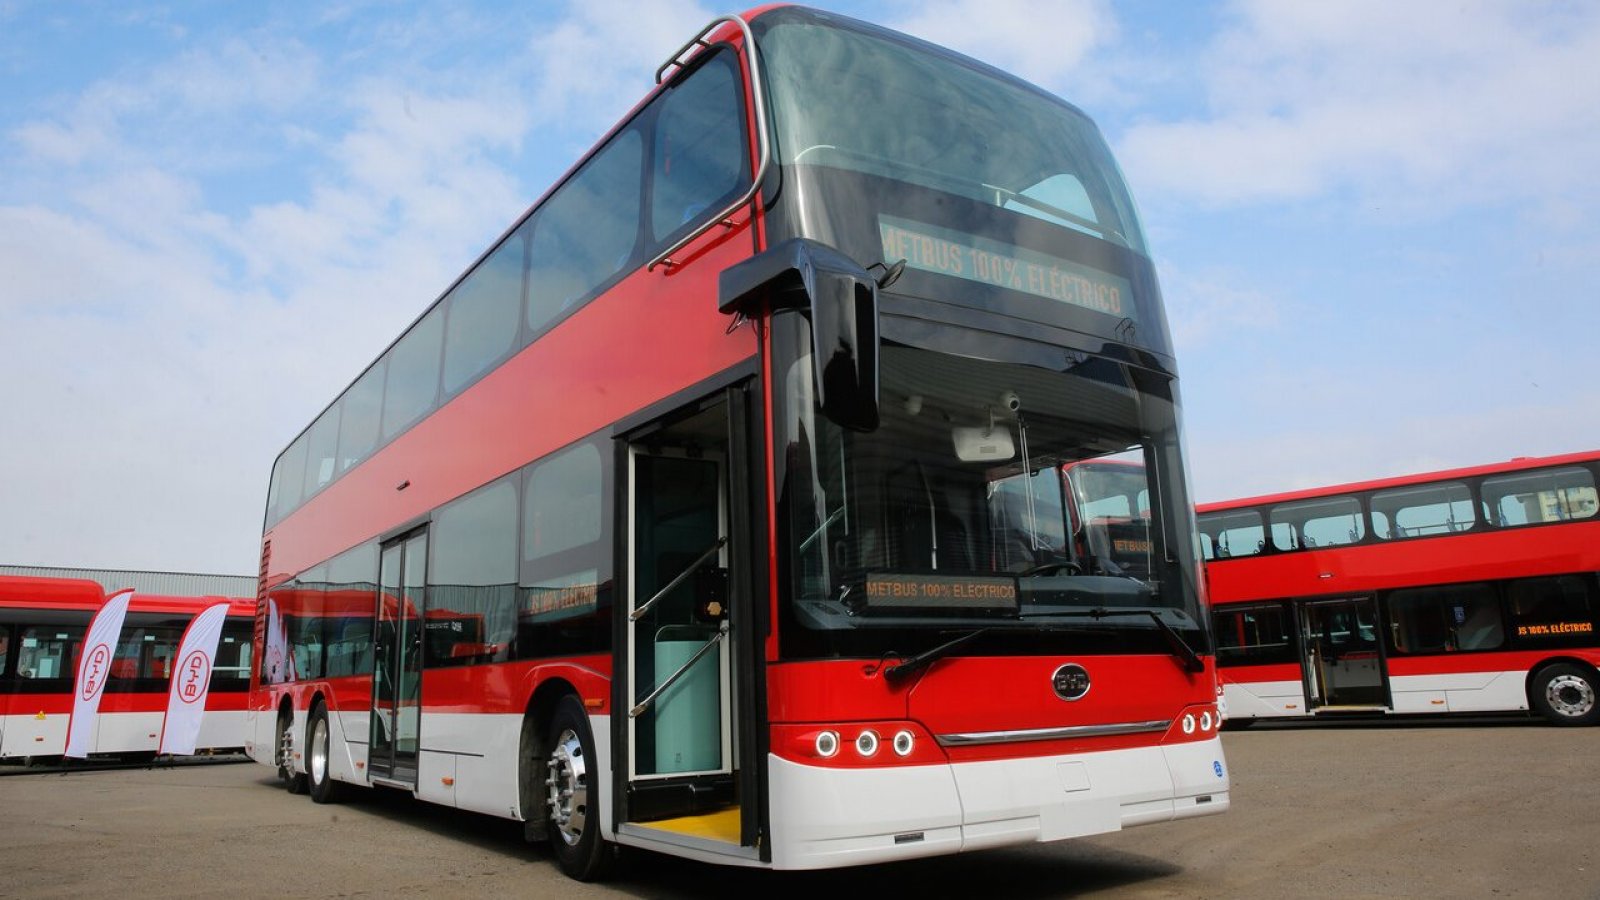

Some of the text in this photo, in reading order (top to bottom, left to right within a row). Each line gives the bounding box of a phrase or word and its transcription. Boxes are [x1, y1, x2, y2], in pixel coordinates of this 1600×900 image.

[970, 249, 1022, 290] 100%
[1028, 264, 1121, 314] ELÉCTRICO
[1114, 539, 1147, 552] ETBUS
[866, 581, 917, 597] METBUS
[921, 583, 950, 598] 100%
[1528, 625, 1549, 635] 100%
[1550, 622, 1592, 633] ELÉCTRICO
[85, 650, 104, 693] BYD
[185, 656, 202, 697] BYD
[1056, 674, 1086, 690] BYD
